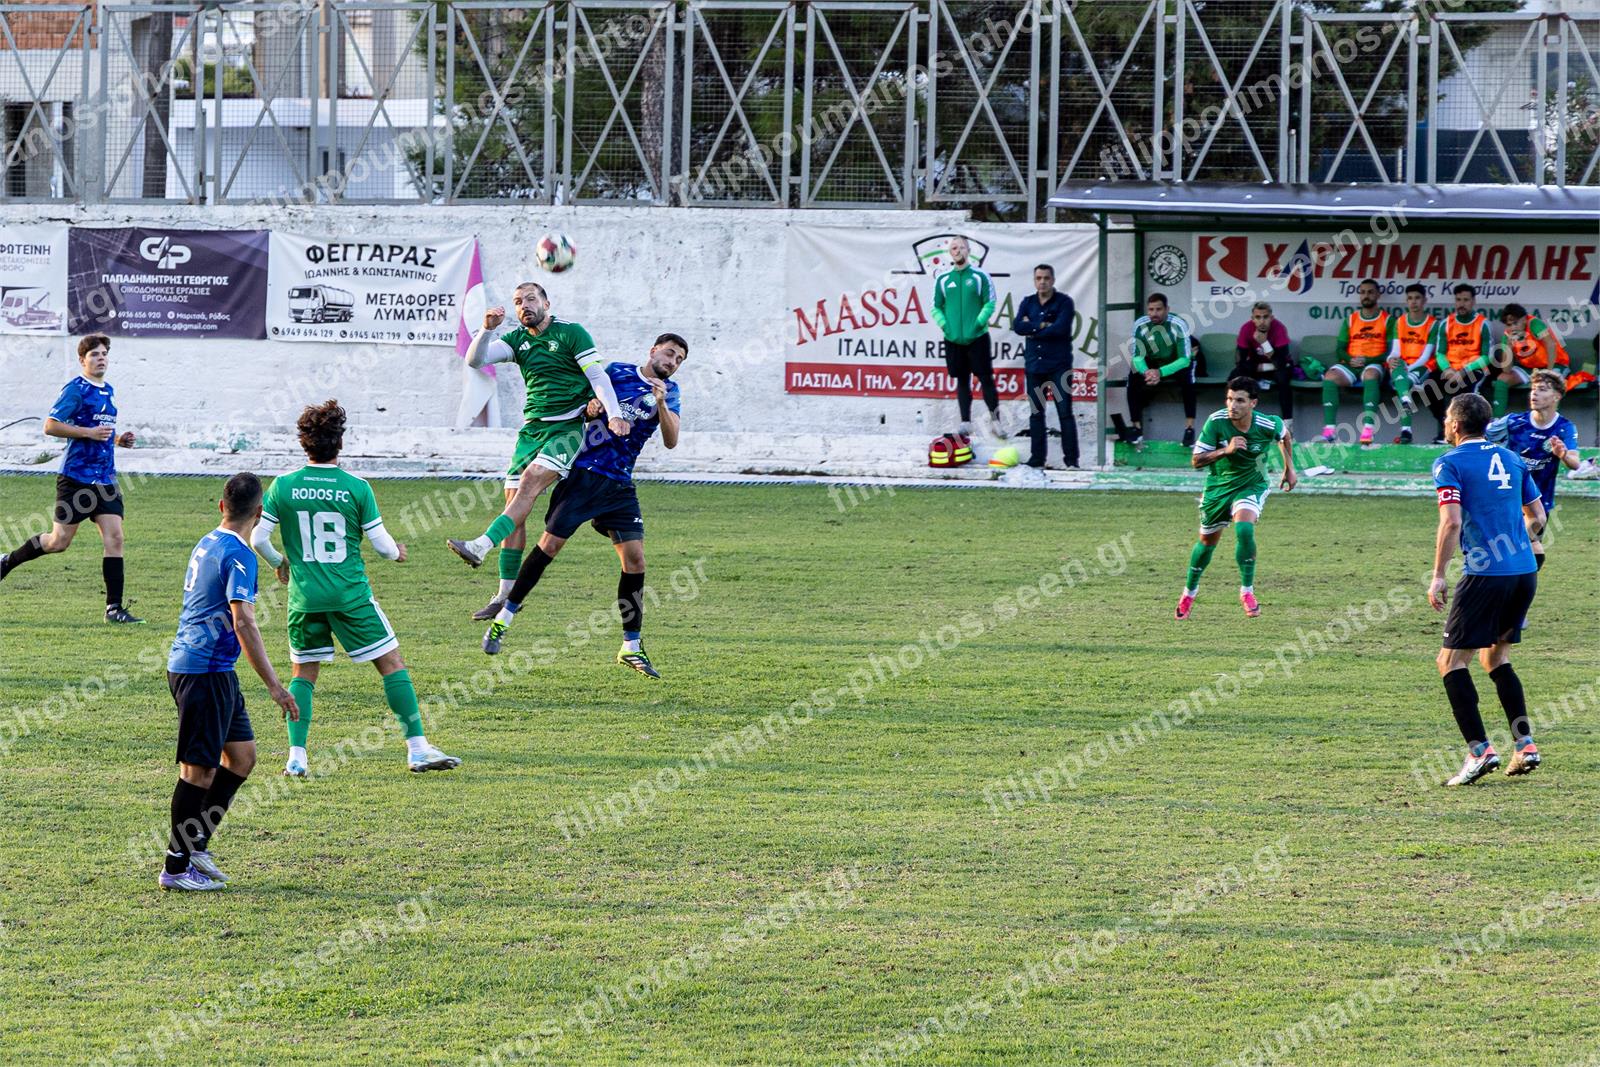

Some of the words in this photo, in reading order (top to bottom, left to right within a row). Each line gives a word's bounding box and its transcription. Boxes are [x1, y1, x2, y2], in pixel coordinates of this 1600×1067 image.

[305, 243, 437, 269] ΦΕΓΓΑΡΑΣ
[102, 274, 182, 285] ΠΑΠΑΔΗΜΗΤΡΗΣ
[184, 275, 229, 286] ΓΕΩΡΓΙΟΣ
[305, 267, 351, 280] ΙΩΑΝΝΗΣ
[353, 267, 359, 276] &
[362, 267, 438, 283] ΚΩΝΣΤΑΝΤΙΝΟΣ
[120, 285, 175, 295] ΟΙΚΟΔΟΜΙΚΕΣ
[176, 287, 211, 296] ΕΡΓΑΣΙΕΣ
[1211, 286, 1246, 296] EKO
[1441, 281, 1520, 299] Κσίμων
[142, 294, 189, 303] ΕΡΓΟΛΑΒΟΣ
[365, 293, 456, 307] ΜΕΤΑΦΟΡΕΣ
[374, 308, 448, 321] ΛΥΜΑΤΩΝ
[793, 286, 928, 346] MASSA
[1551, 309, 1591, 323] 2021
[320, 329, 333, 338] 129
[838, 338, 917, 358] ITALIAN
[792, 372, 853, 388] ΠΑΣΤΙΔΑ
[865, 375, 897, 390] ΤΗΛ.
[902, 371, 958, 392] 22410
[1072, 383, 1098, 396] 23:3
[1488, 452, 1513, 490] 4
[292, 487, 333, 501] RODOS
[335, 490, 350, 503] FC
[296, 510, 347, 563] 18
